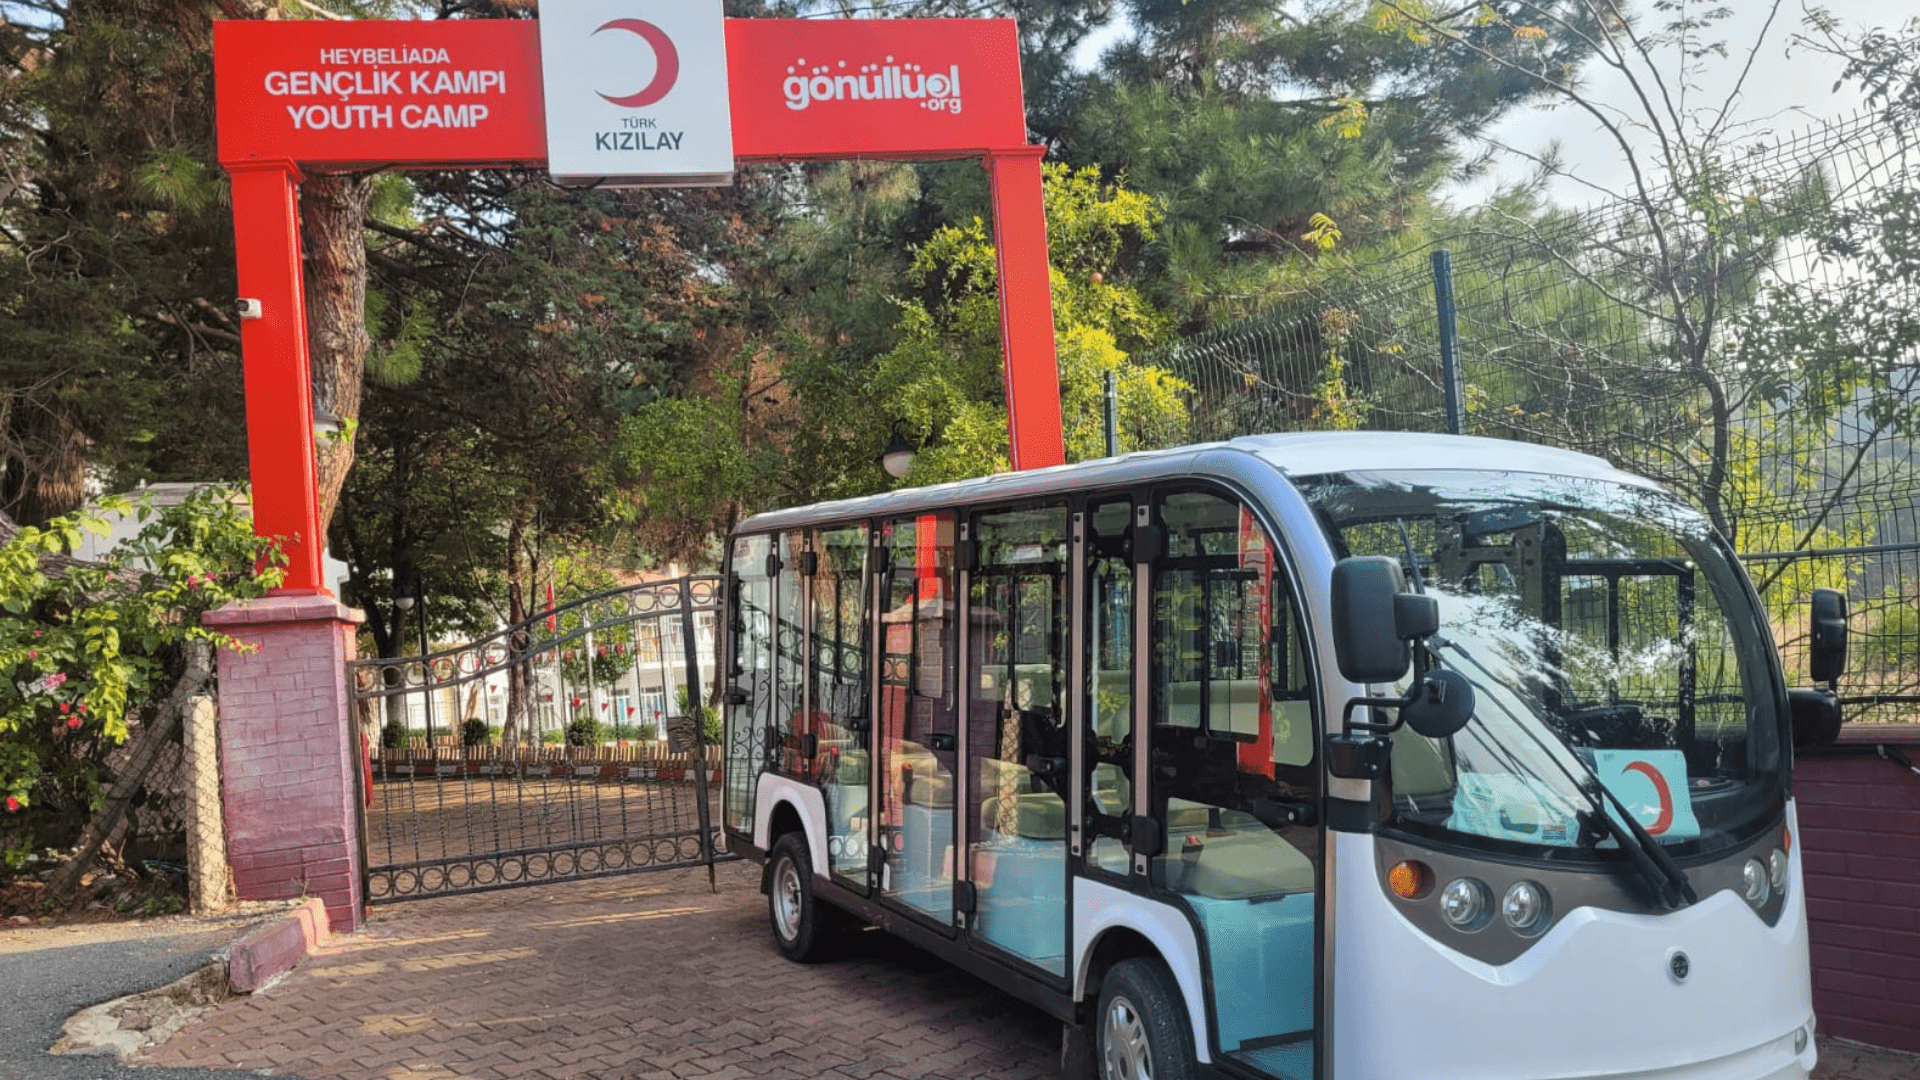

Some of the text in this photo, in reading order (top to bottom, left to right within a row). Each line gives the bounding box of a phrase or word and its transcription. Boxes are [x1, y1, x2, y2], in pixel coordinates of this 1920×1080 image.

[320, 44, 450, 64] HEYBELİADA
[264, 65, 506, 101] GENÇLİK KAMPI
[920, 97, 962, 114] .org
[287, 104, 489, 129] YOUTH CAMP
[621, 116, 657, 128] TÜRK
[595, 131, 684, 150] KIZILAY
